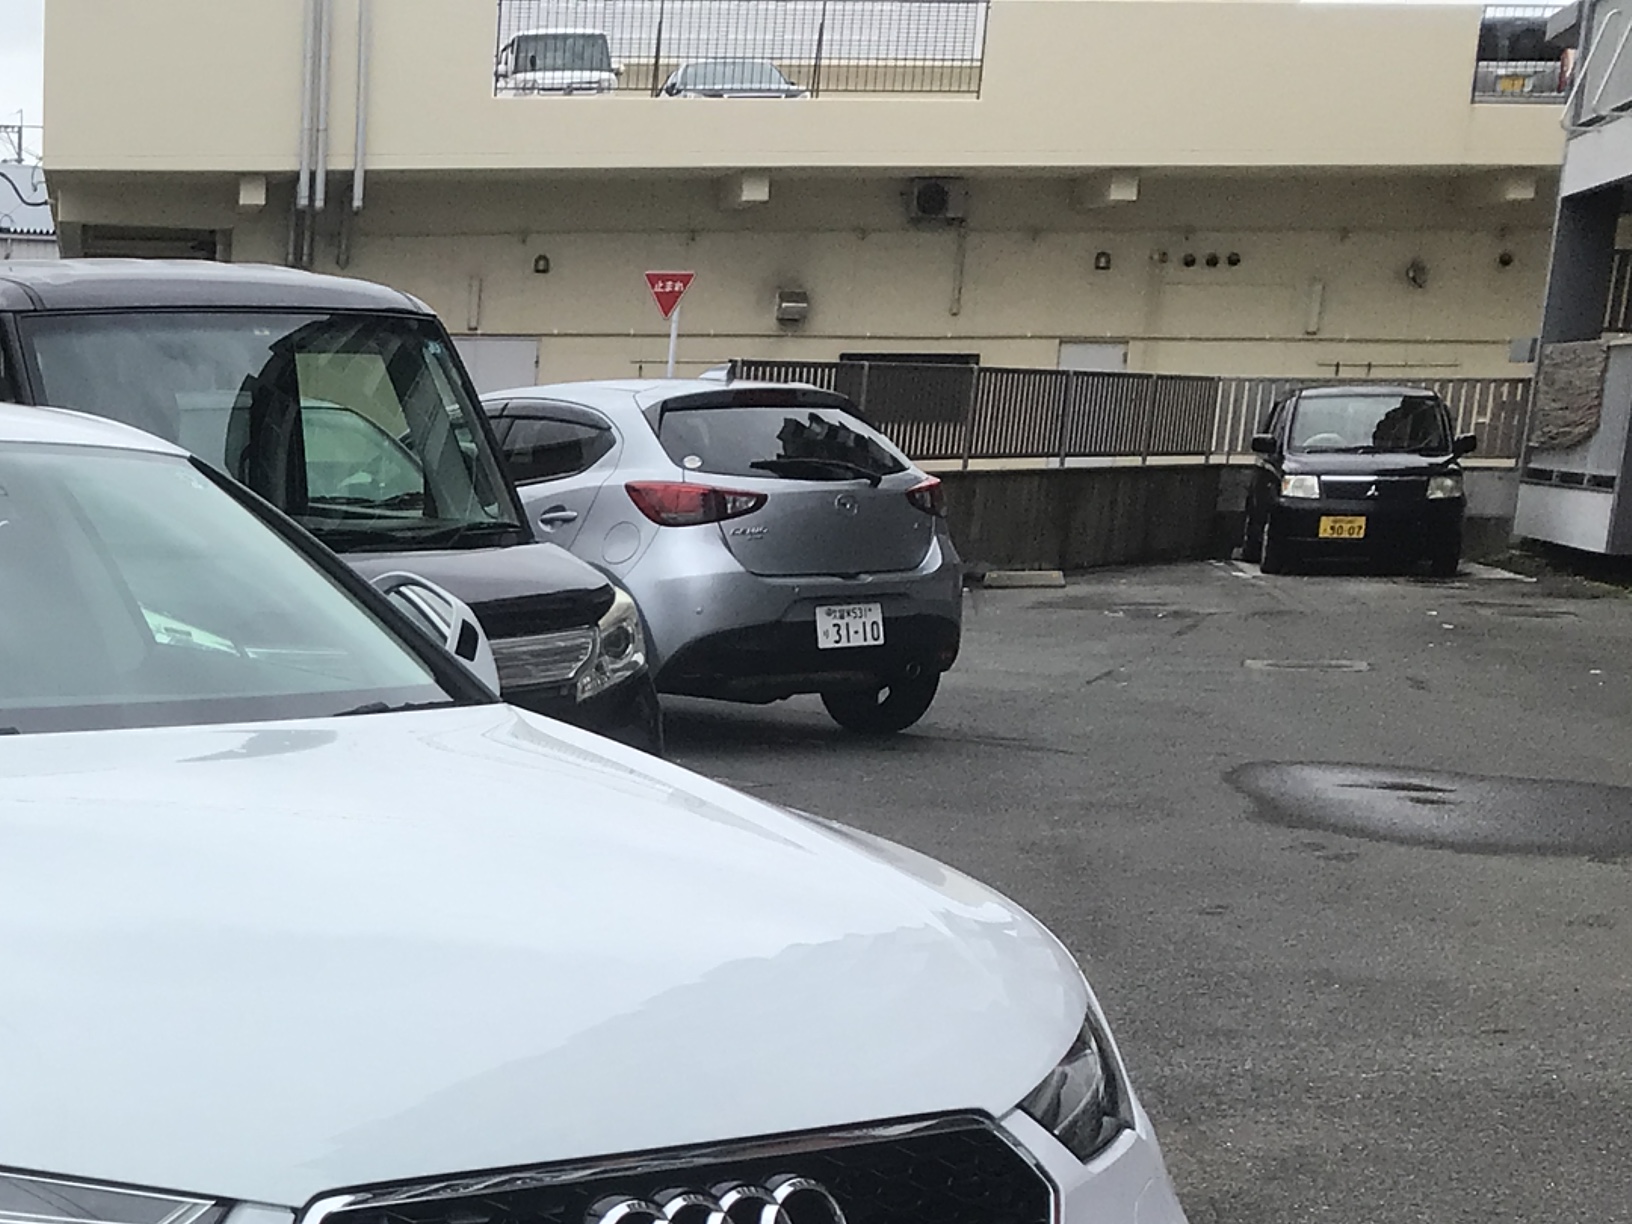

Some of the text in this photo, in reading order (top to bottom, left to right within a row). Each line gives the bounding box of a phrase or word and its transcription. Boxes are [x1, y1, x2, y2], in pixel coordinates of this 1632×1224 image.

[654, 280, 684, 292] 止まれ
[832, 620, 880, 645] 31-10
